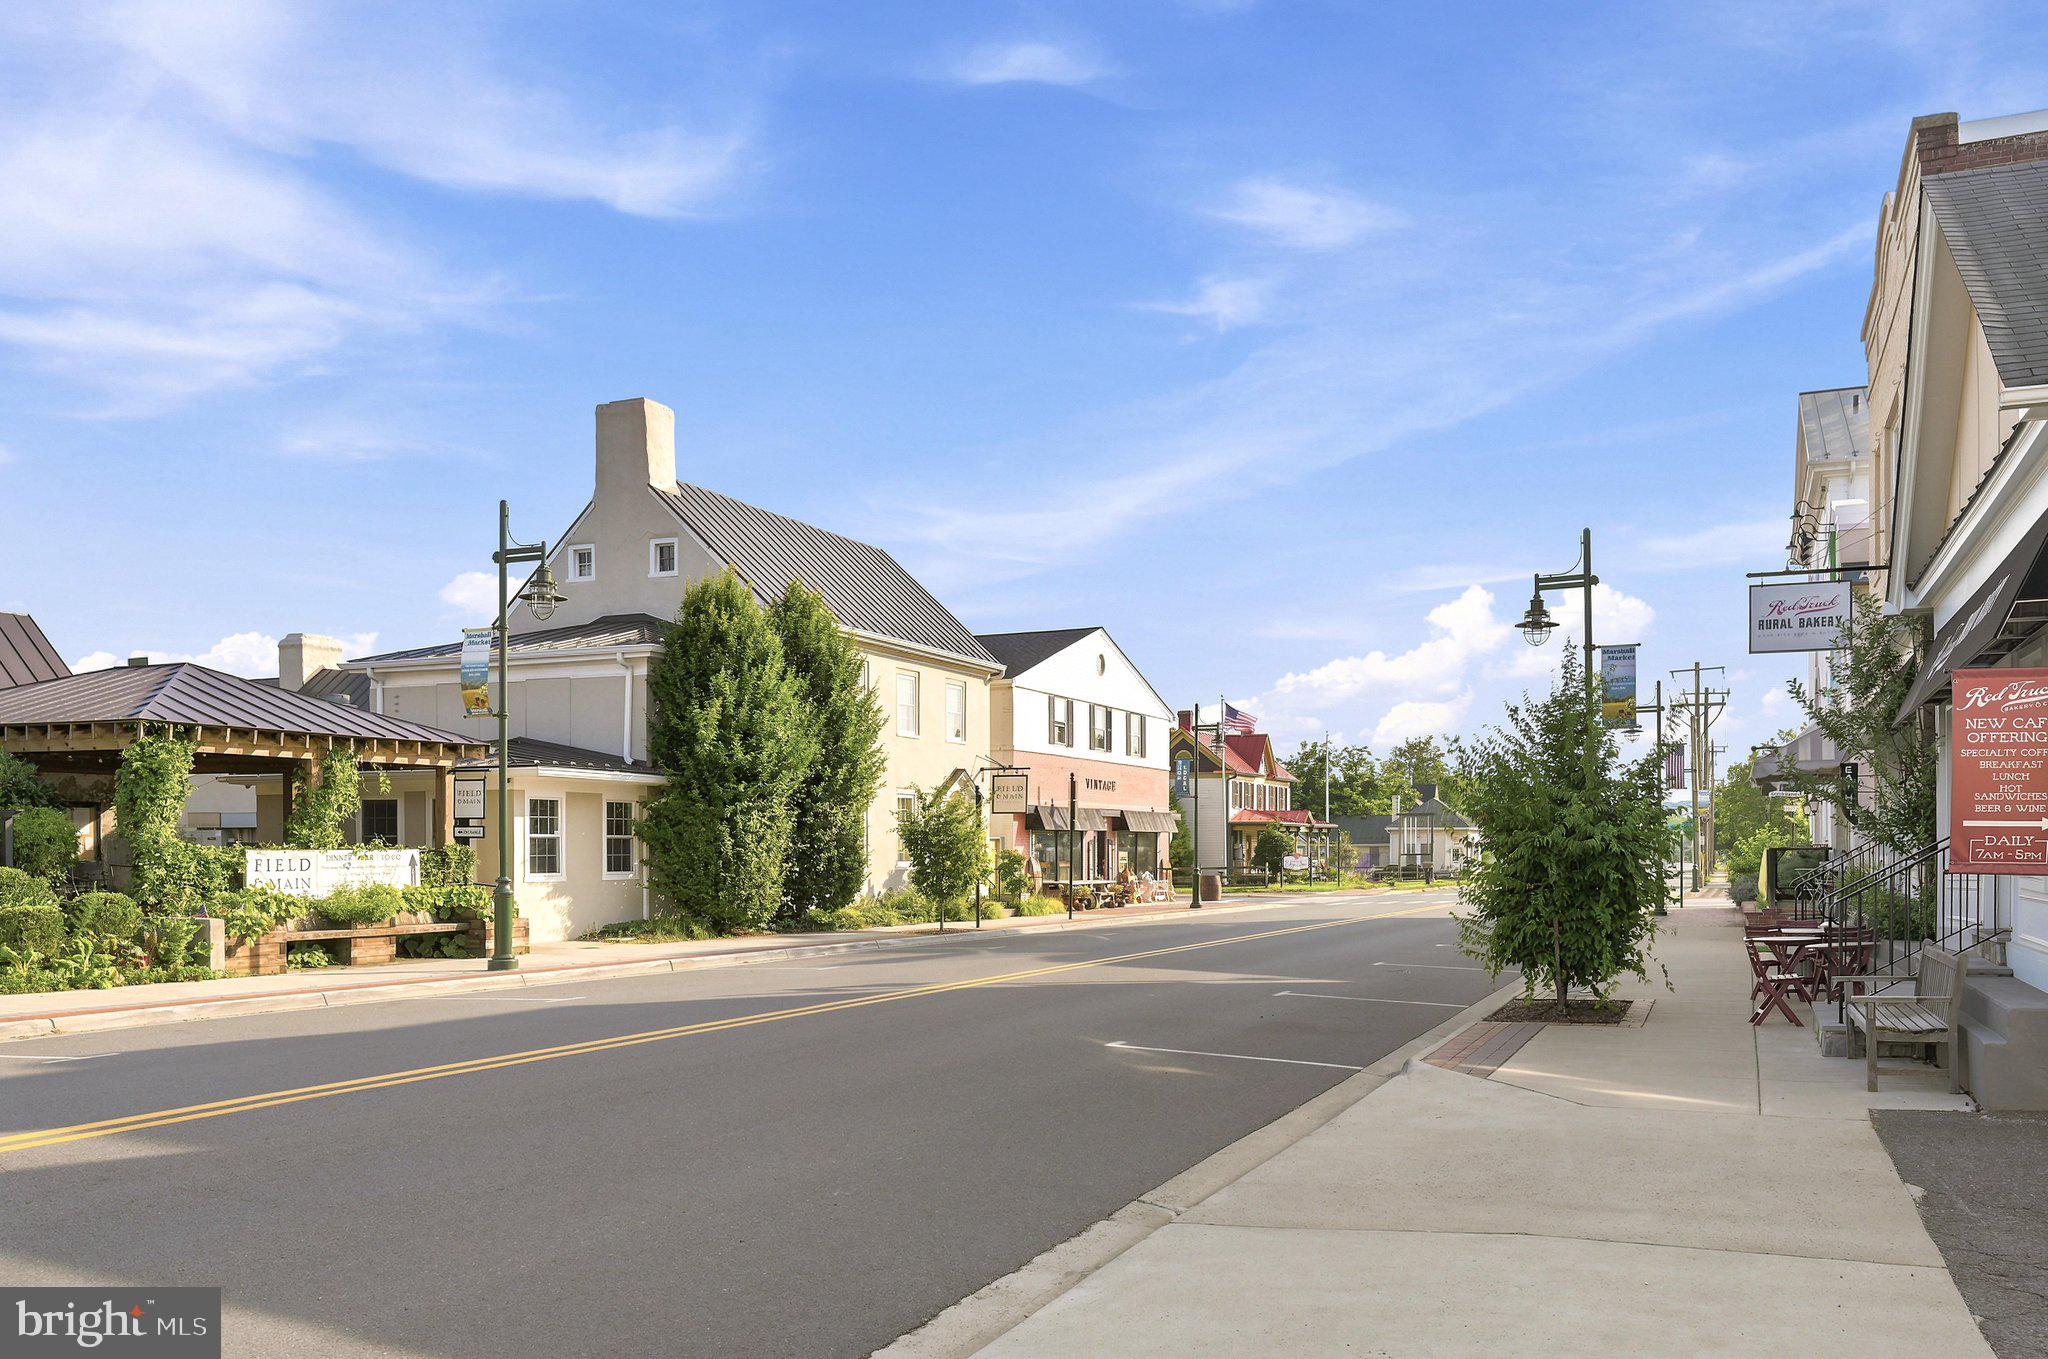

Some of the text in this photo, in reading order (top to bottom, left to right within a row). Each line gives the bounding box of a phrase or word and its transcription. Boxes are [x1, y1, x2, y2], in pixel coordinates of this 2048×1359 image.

[1765, 594, 1840, 617] Red Truck
[1758, 615, 1843, 631] RURAL BAKERY
[465, 631, 492, 639] Marshall
[1956, 686, 2009, 711] Red
[2004, 703, 2034, 712] BAKERY
[1965, 717, 2008, 730] NEW
[1967, 732, 2048, 743] OFFERING
[1961, 748, 2018, 757] SPECIALTY
[1979, 760, 2044, 769] BREAKFAST
[1992, 772, 2031, 781] LUNCH
[1085, 778, 1116, 792] VINTAGE
[1999, 784, 2023, 793] HOT
[1974, 792, 2048, 801] SANDWICHES
[1974, 804, 2002, 813] BEER
[2015, 804, 2047, 813] WINE
[1984, 835, 2035, 846] DAILY
[1975, 848, 2004, 860] 7AM
[2014, 849, 2042, 860] 5PM
[254, 858, 311, 872] FIELD
